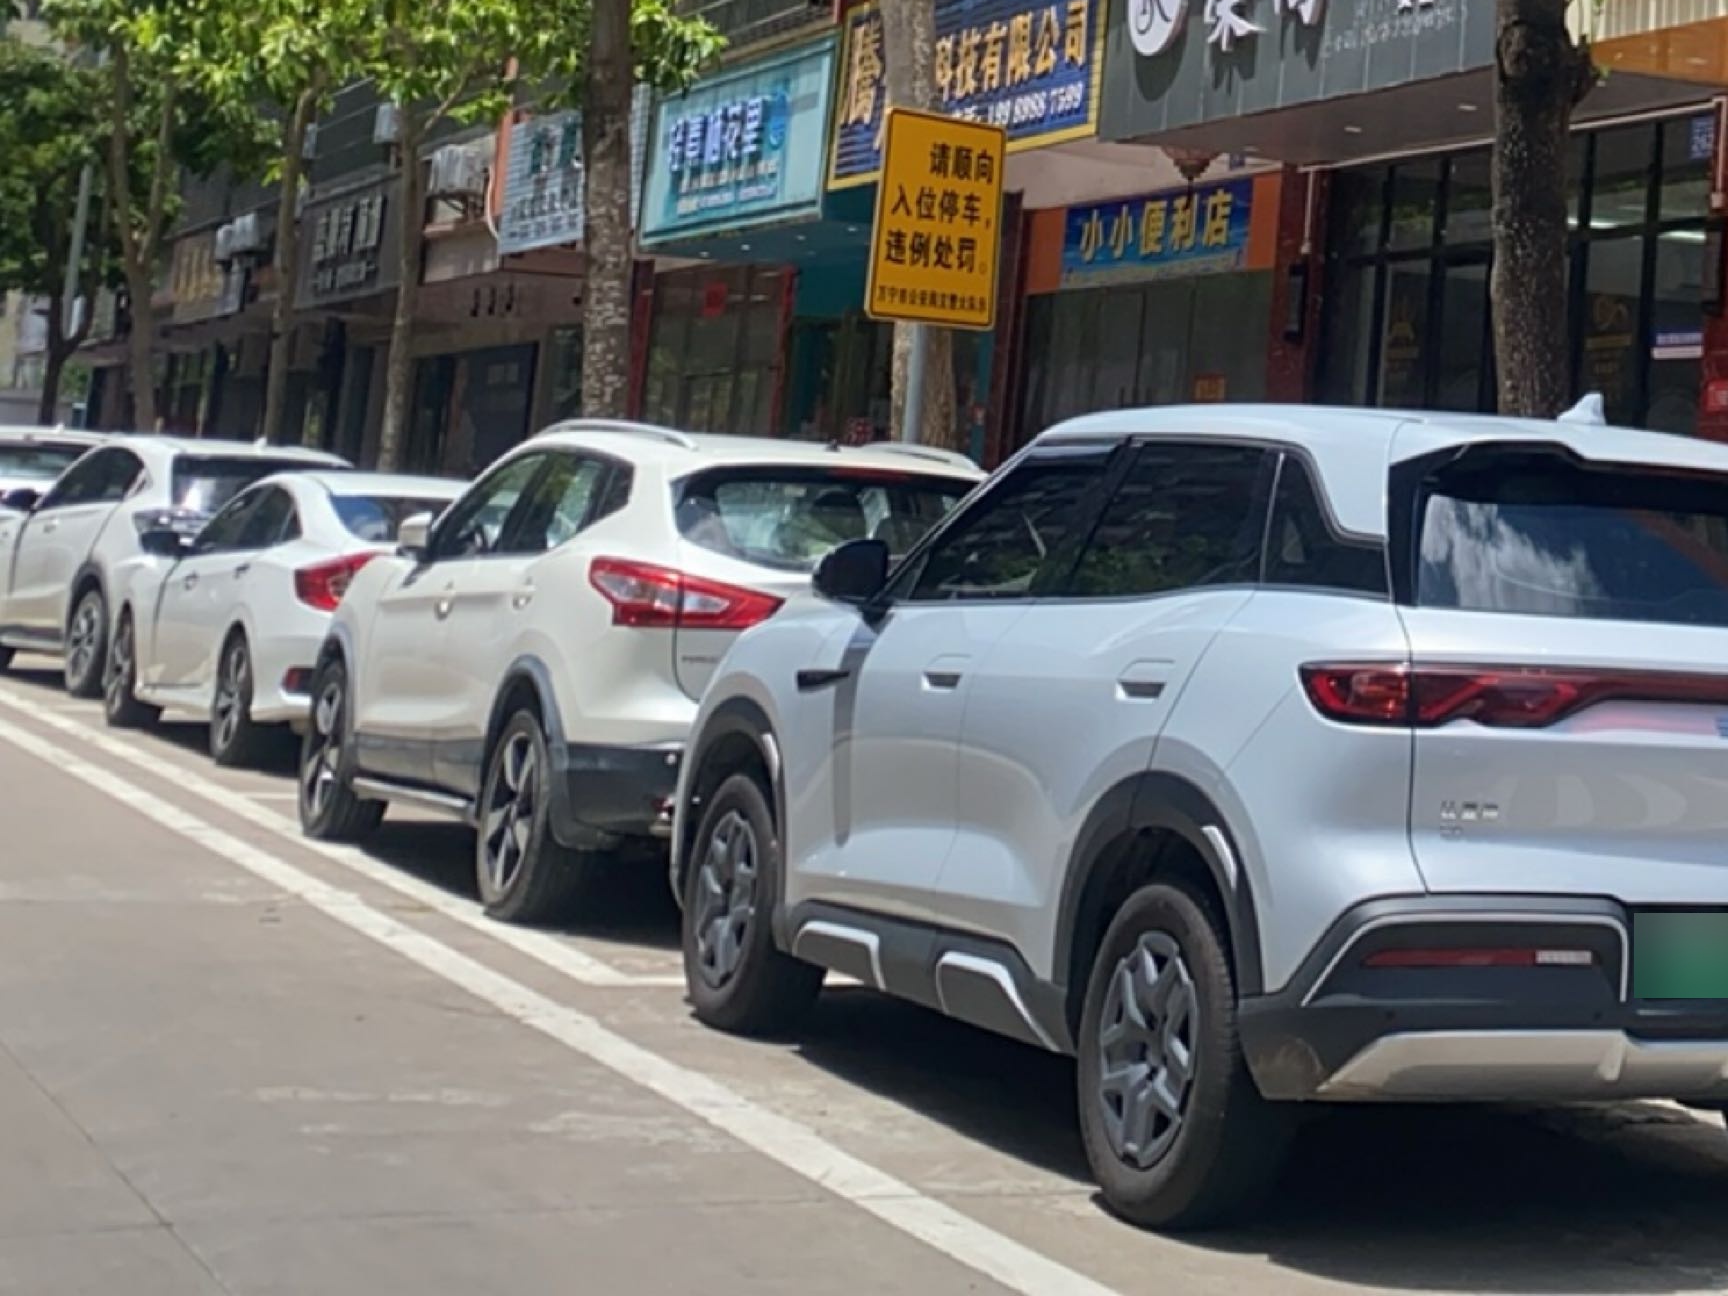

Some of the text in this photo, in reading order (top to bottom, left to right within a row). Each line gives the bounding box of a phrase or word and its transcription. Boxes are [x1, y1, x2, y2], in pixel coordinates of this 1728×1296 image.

[929, 141, 994, 185] 请顺向
[1079, 188, 1233, 263] 小小便利店
